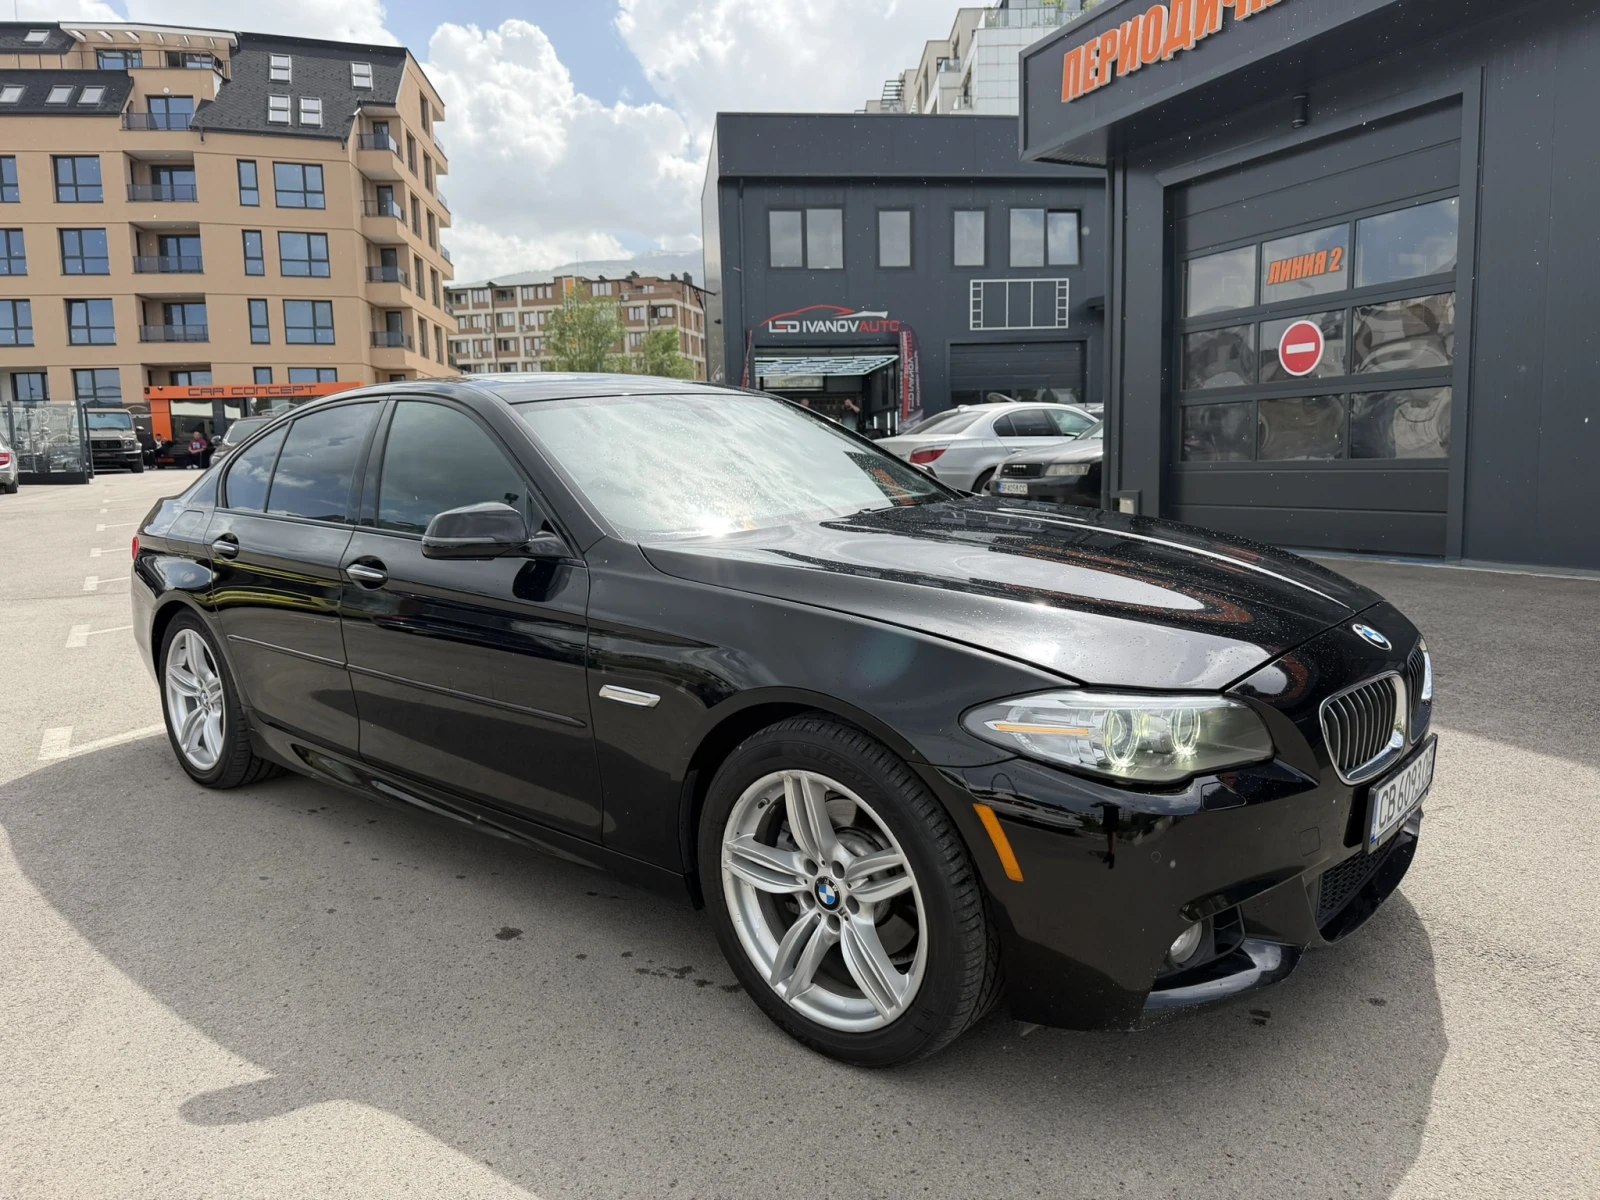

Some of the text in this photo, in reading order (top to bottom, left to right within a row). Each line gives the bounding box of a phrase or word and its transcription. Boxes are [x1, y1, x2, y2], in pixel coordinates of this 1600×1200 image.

[1061, 0, 1281, 103] ПЕРИОДИ
[1267, 246, 1344, 285] ЛИНИЯ 2
[768, 320, 800, 333] LED
[188, 385, 316, 397] CAR CONCEPT
[1379, 784, 1397, 829] CB
[1397, 760, 1422, 813] 6093
